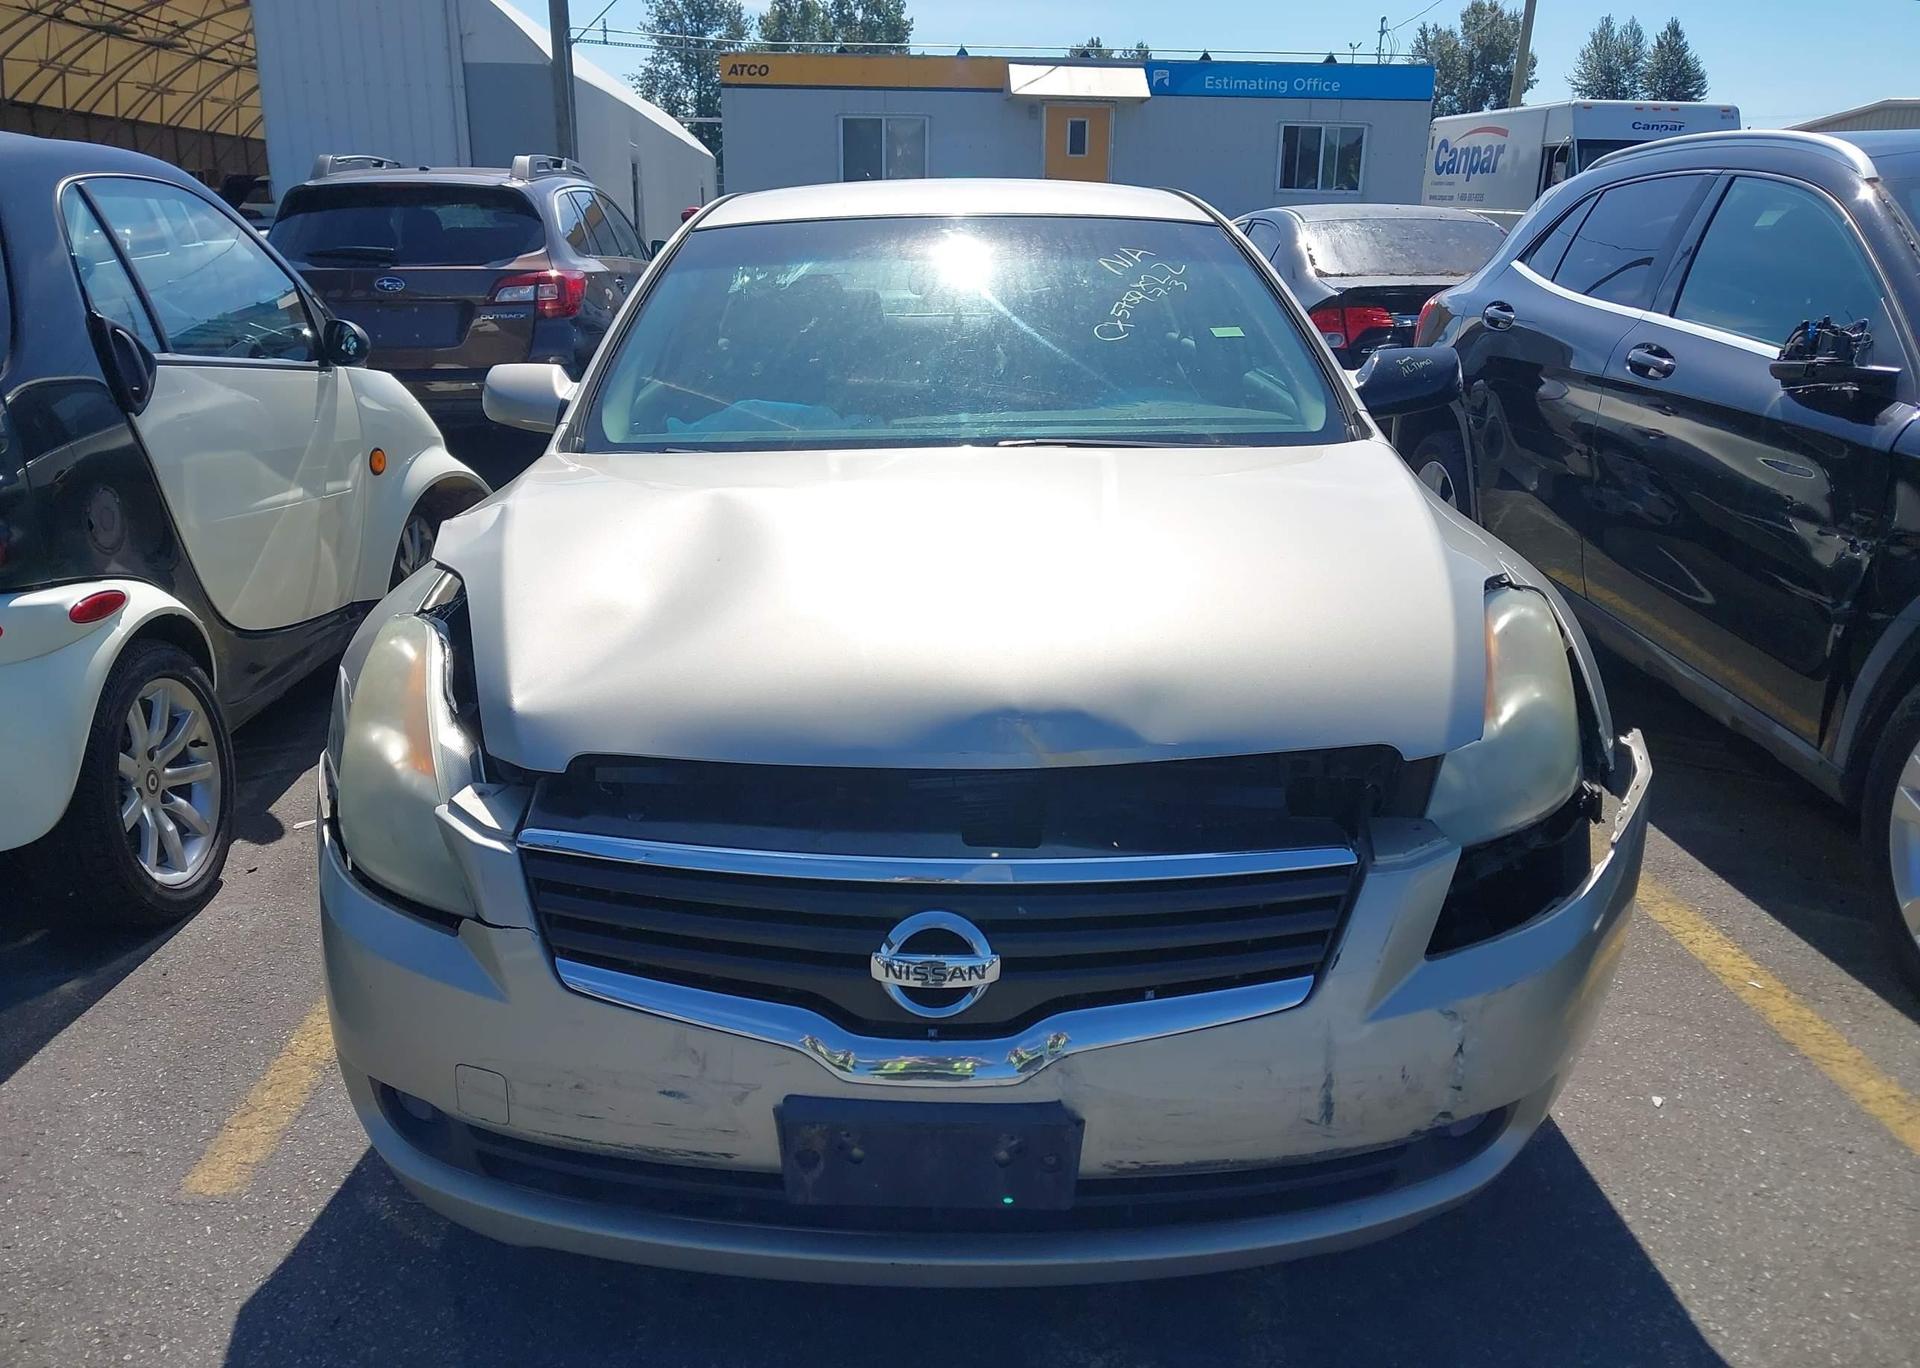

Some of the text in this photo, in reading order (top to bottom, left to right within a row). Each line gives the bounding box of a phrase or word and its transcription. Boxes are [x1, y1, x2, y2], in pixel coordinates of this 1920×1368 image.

[727, 64, 770, 77] ATCO
[1205, 76, 1341, 93] Estimating Office
[1631, 121, 1686, 132] Canpar
[1434, 138, 1506, 182] Canpar
[884, 963, 987, 982] NISSAN
